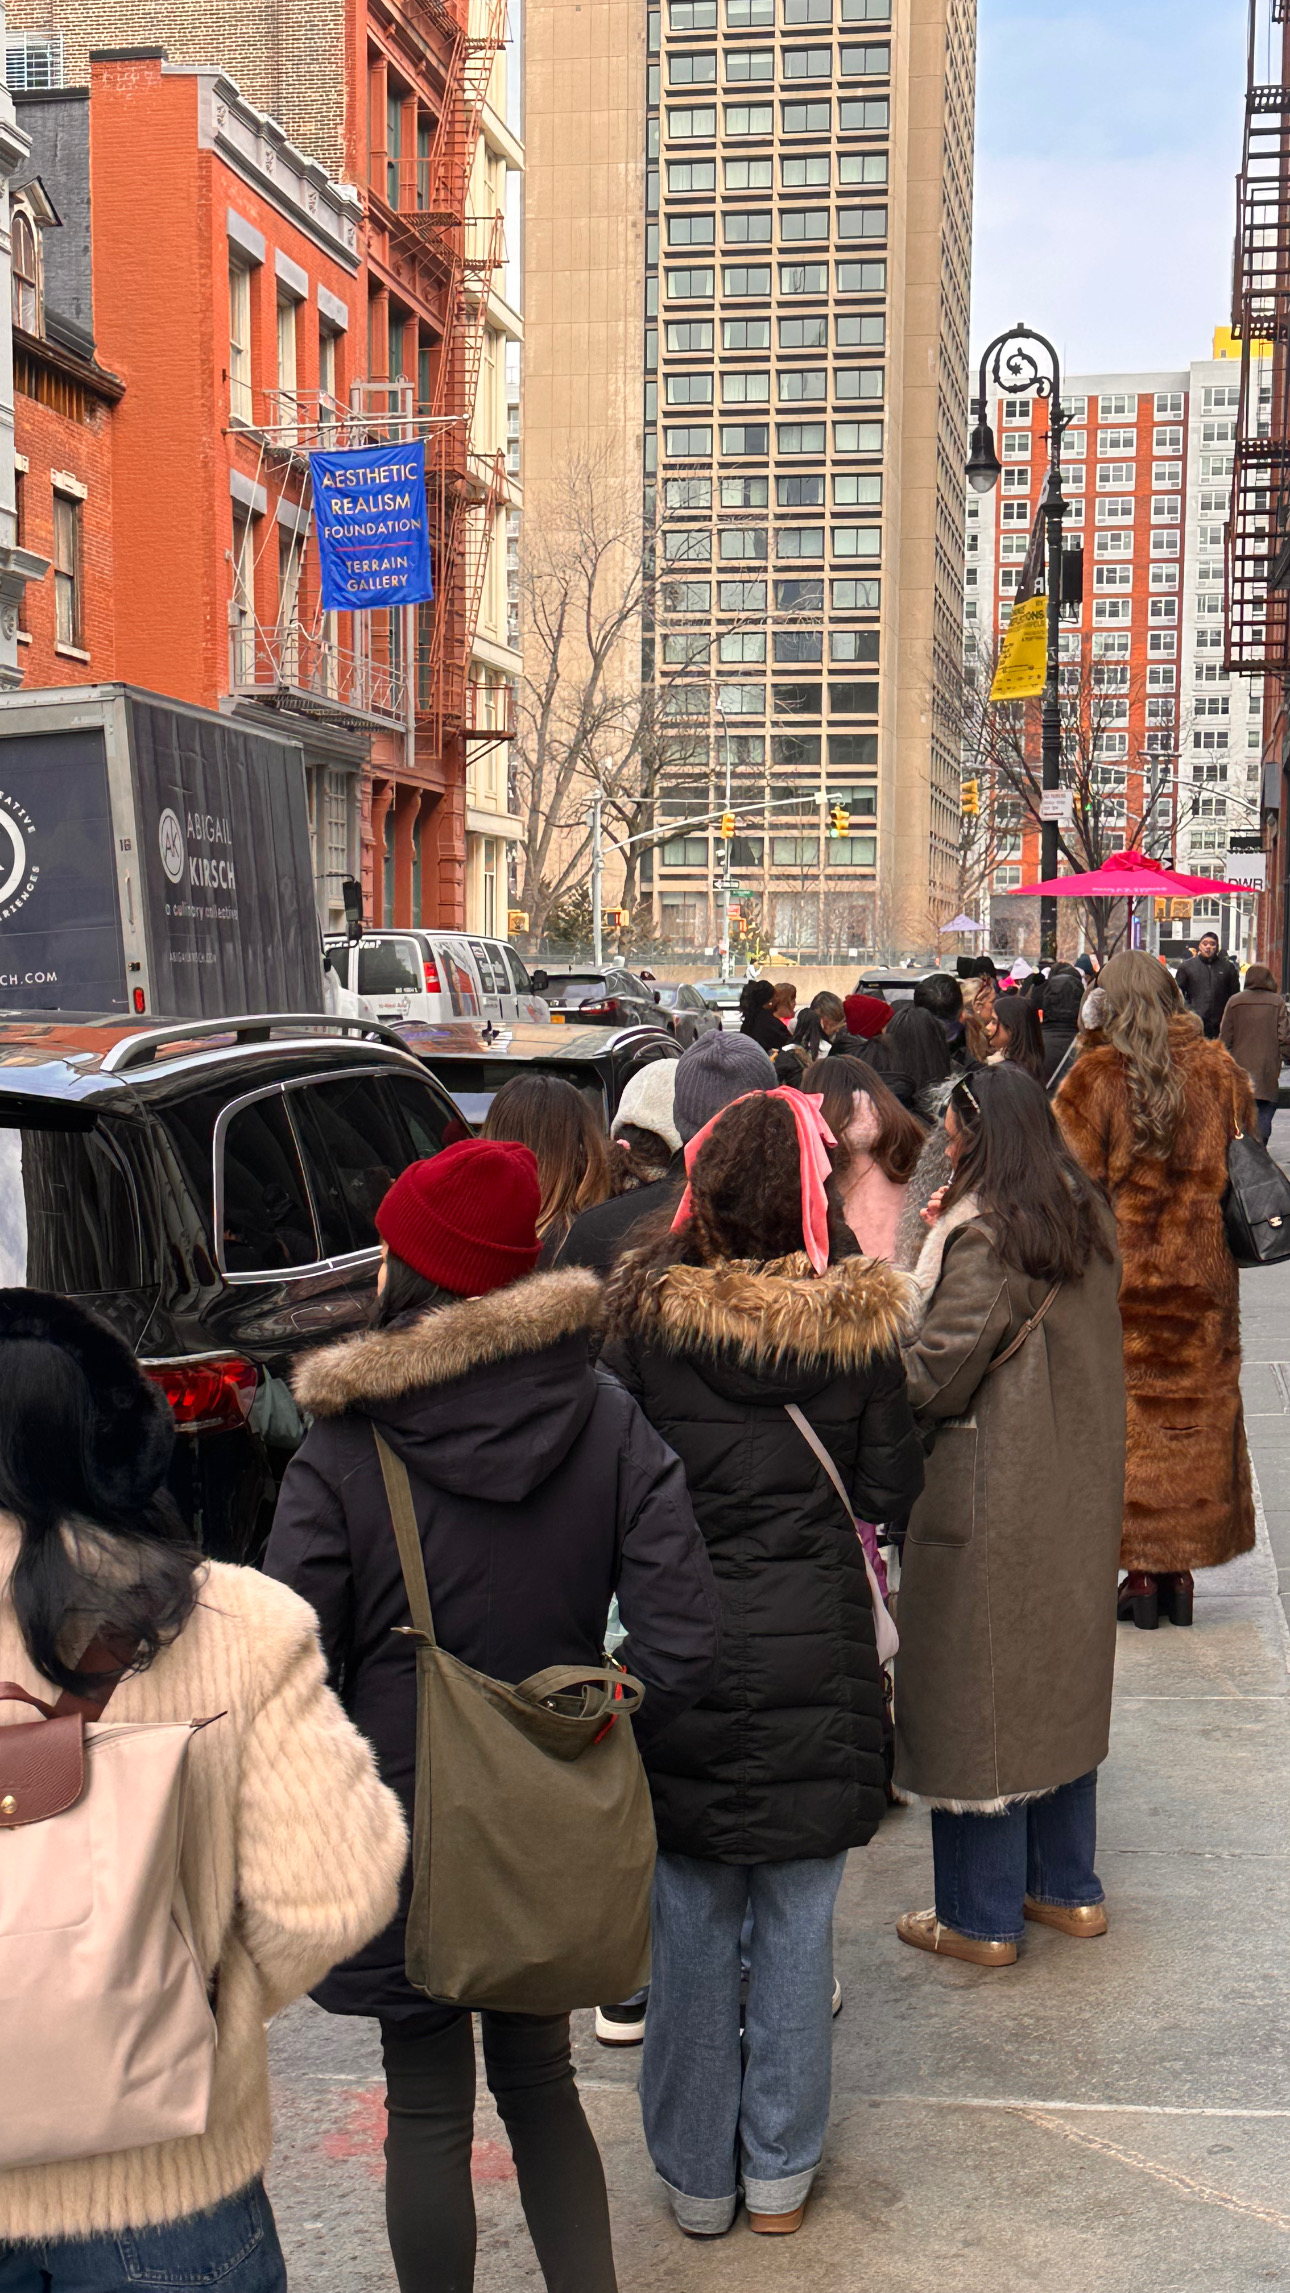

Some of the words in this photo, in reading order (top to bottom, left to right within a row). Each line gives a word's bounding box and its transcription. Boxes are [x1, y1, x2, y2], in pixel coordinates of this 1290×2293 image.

[321, 463, 418, 488] AESTHETIC
[331, 493, 411, 515] REALISM
[324, 518, 421, 539] FOUNDATION
[346, 556, 408, 573] TERRAIN
[346, 574, 408, 592] GALLERY
[186, 811, 232, 845] ABIGAIL
[189, 856, 236, 890] KIRSCH
